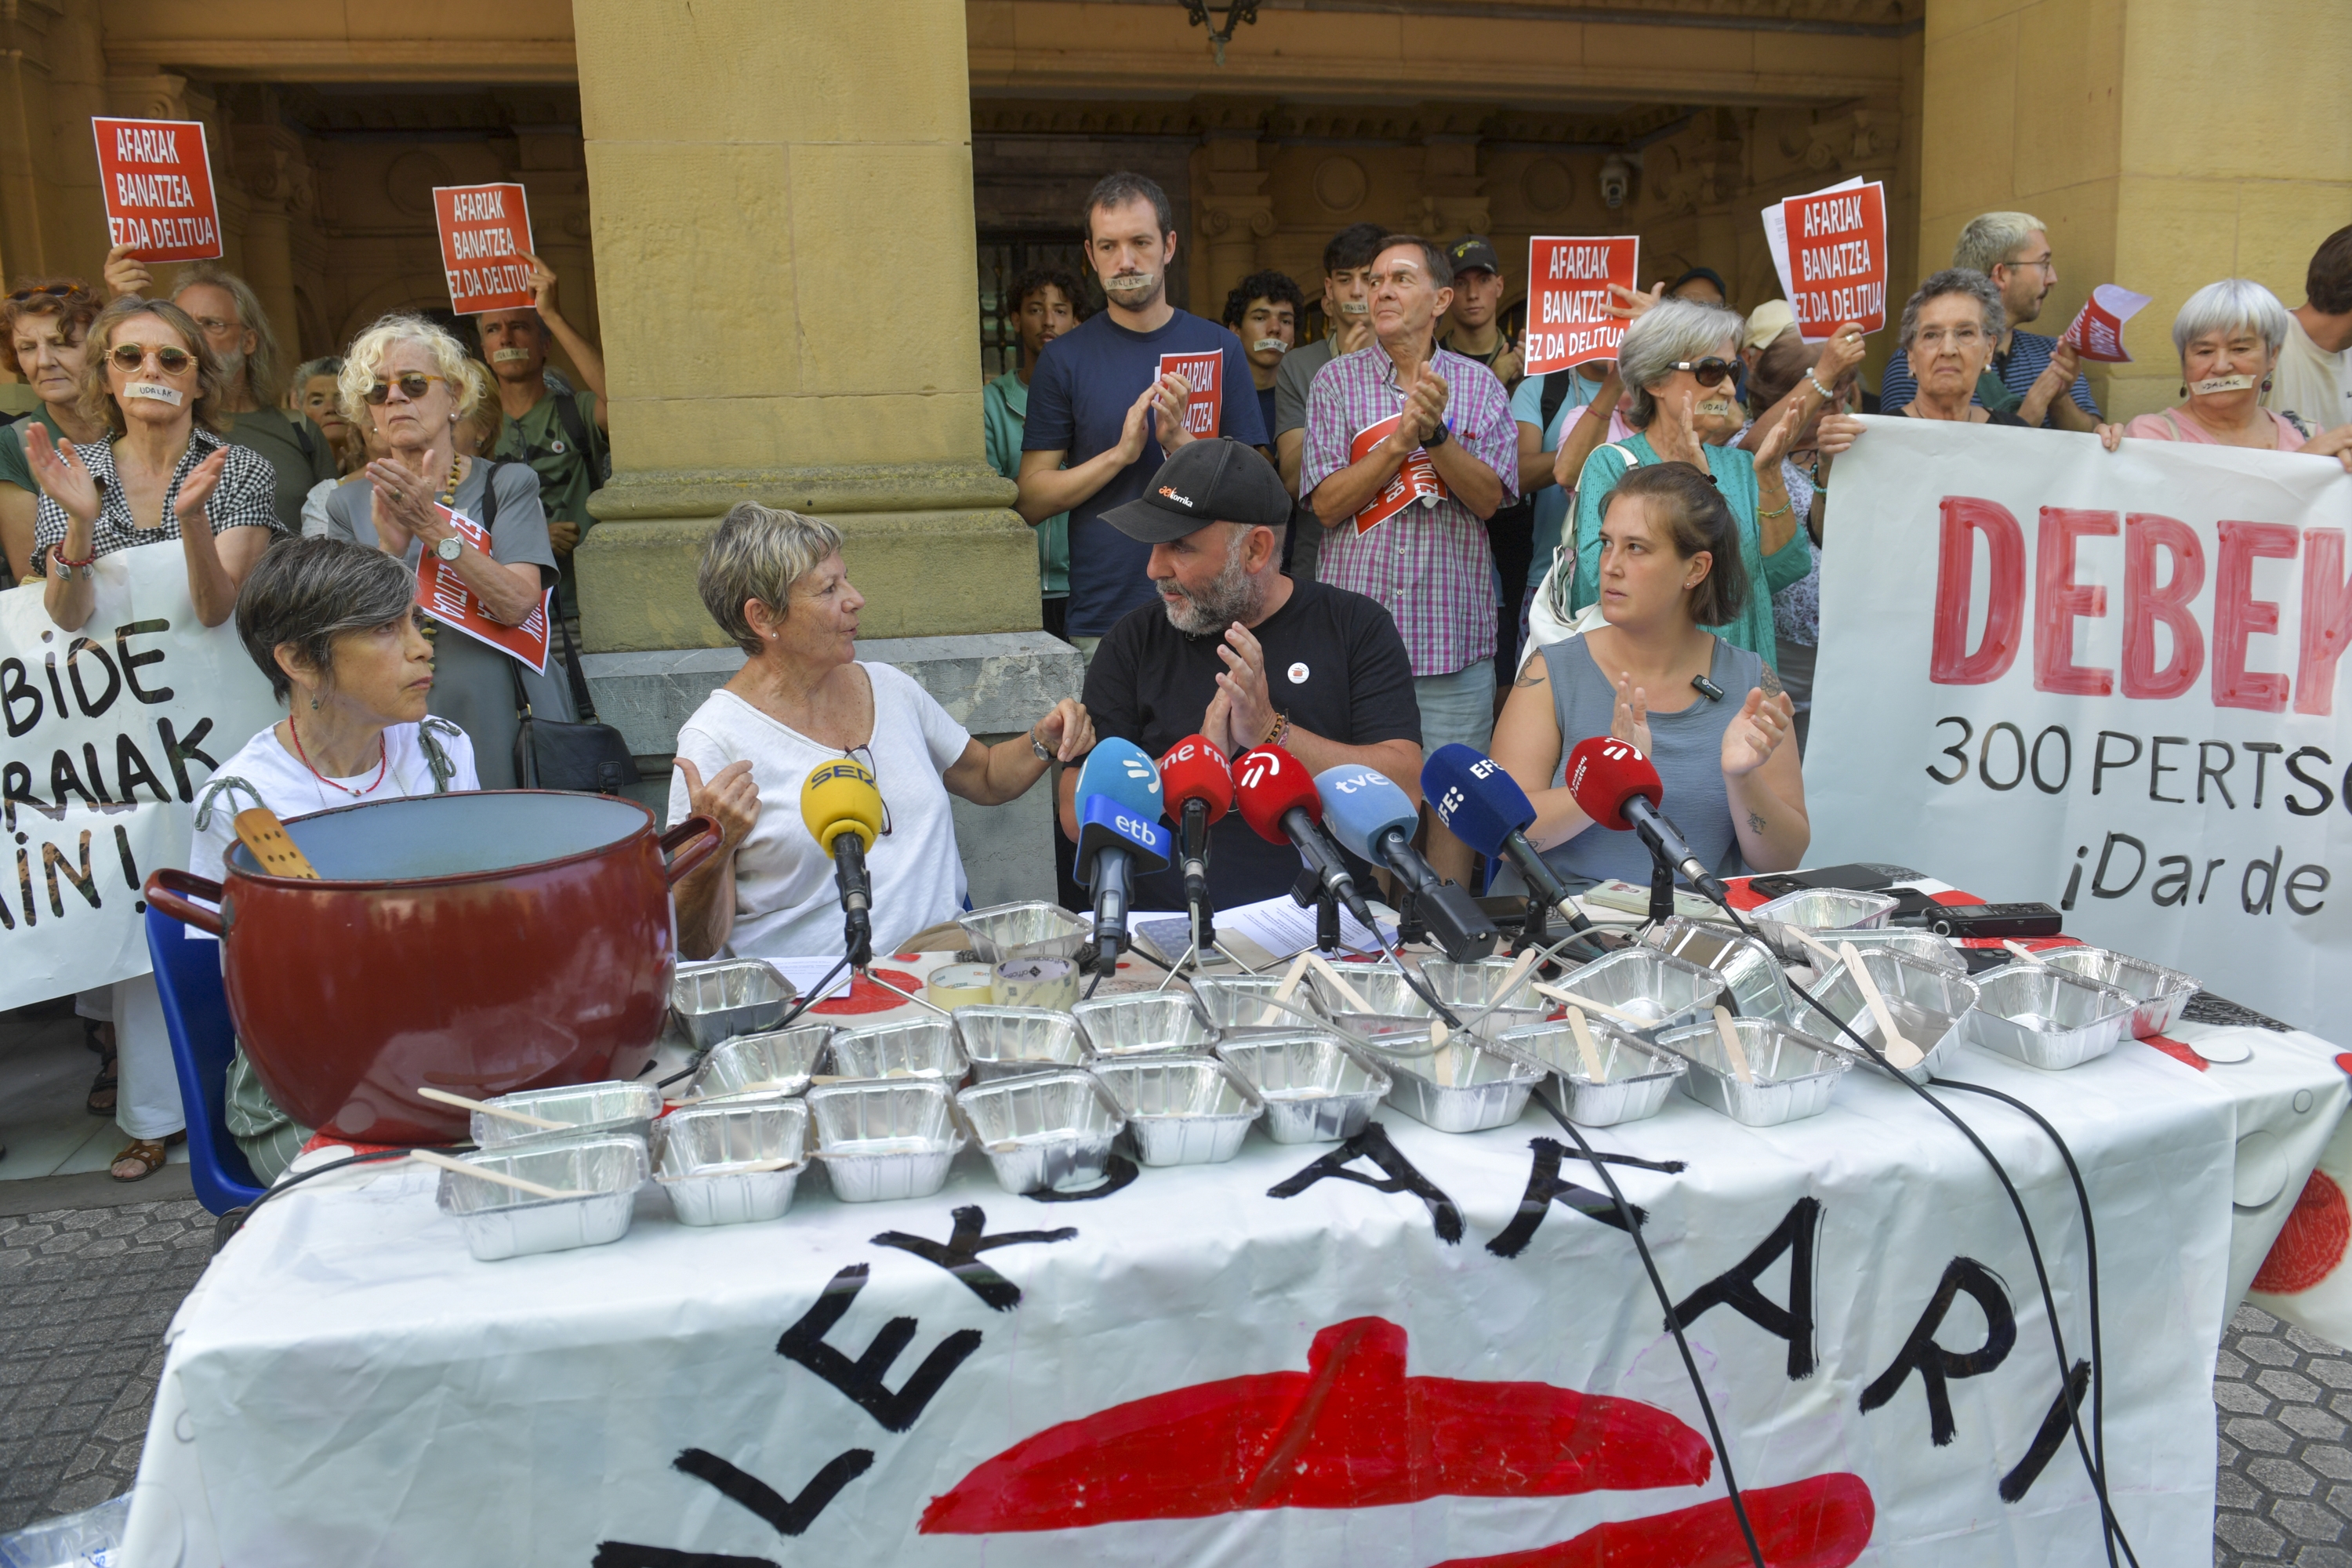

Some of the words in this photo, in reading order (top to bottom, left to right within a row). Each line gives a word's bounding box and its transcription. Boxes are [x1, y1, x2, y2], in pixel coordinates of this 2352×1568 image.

[117, 128, 180, 164] AFARIAK
[116, 173, 194, 207] BANATZEA
[454, 191, 505, 222] AFARIAK
[1805, 195, 1863, 238] AFARIAK
[110, 217, 124, 247] EZ
[128, 218, 152, 249] DA
[151, 217, 216, 249] DELITUA
[452, 227, 516, 260] BANATZEA
[1549, 246, 1610, 279] AFARIAK
[1802, 239, 1871, 281] BANATZEA
[447, 270, 464, 299] EZ
[463, 268, 485, 296] DA
[1108, 278, 1141, 287] UDALAK
[1543, 291, 1613, 323] BANATZEA
[1794, 292, 1811, 323] EZ
[1811, 291, 1831, 322] DA
[1832, 281, 1882, 321] DELITUA
[1528, 334, 1543, 361] EZ
[1546, 333, 1565, 360] DA
[140, 387, 172, 397] UDALAK
[2202, 379, 2240, 390] UDALAK
[1181, 401, 1213, 433] ATZEA
[433, 564, 467, 619] ELITUA
[1926, 717, 2071, 794] 300
[811, 765, 876, 790] SER
[1335, 773, 1389, 793] tve
[1115, 815, 1156, 846] etb
[2241, 844, 2330, 916] de
